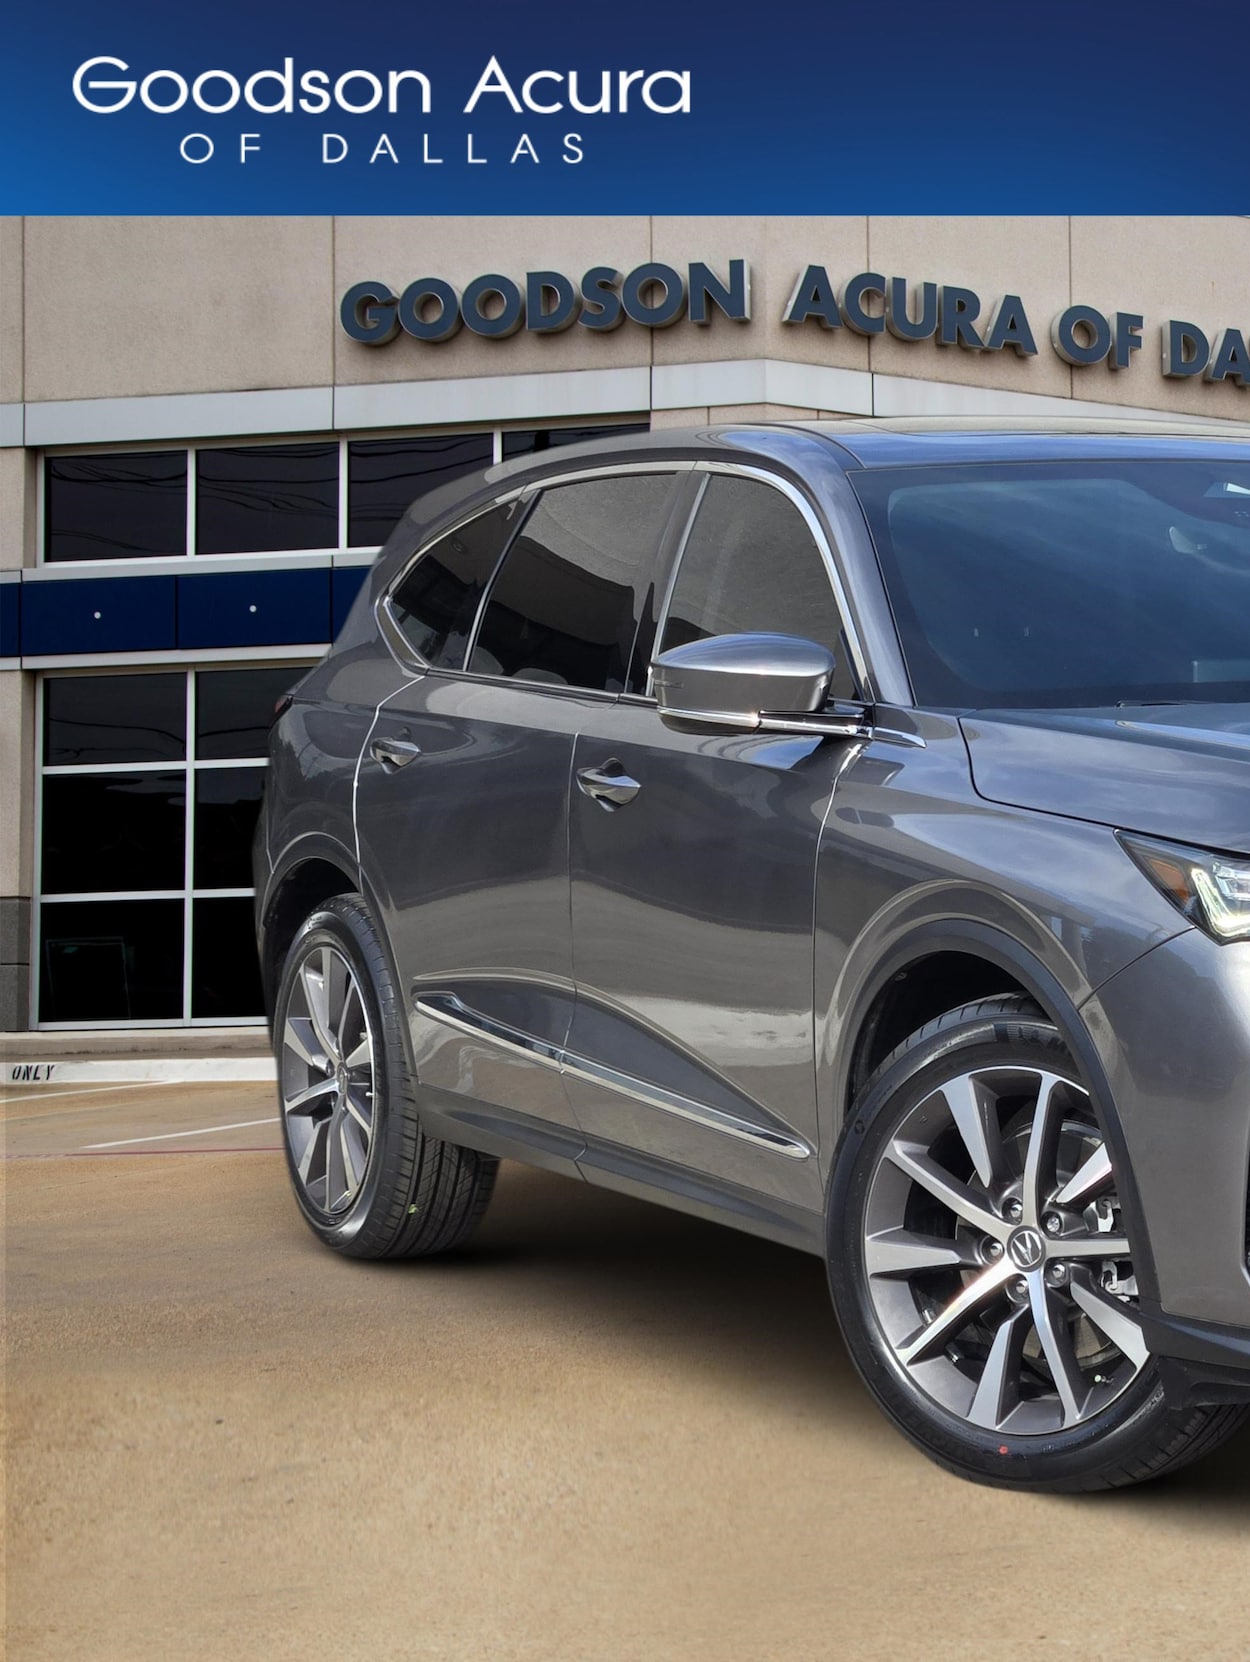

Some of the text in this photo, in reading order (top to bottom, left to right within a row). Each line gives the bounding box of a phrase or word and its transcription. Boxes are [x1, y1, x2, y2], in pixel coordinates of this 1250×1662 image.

[340, 259, 751, 346] GOODSON
[783, 264, 1038, 357] ACURA
[1050, 304, 1143, 369] OF
[12, 1064, 55, 1081] ONLY
